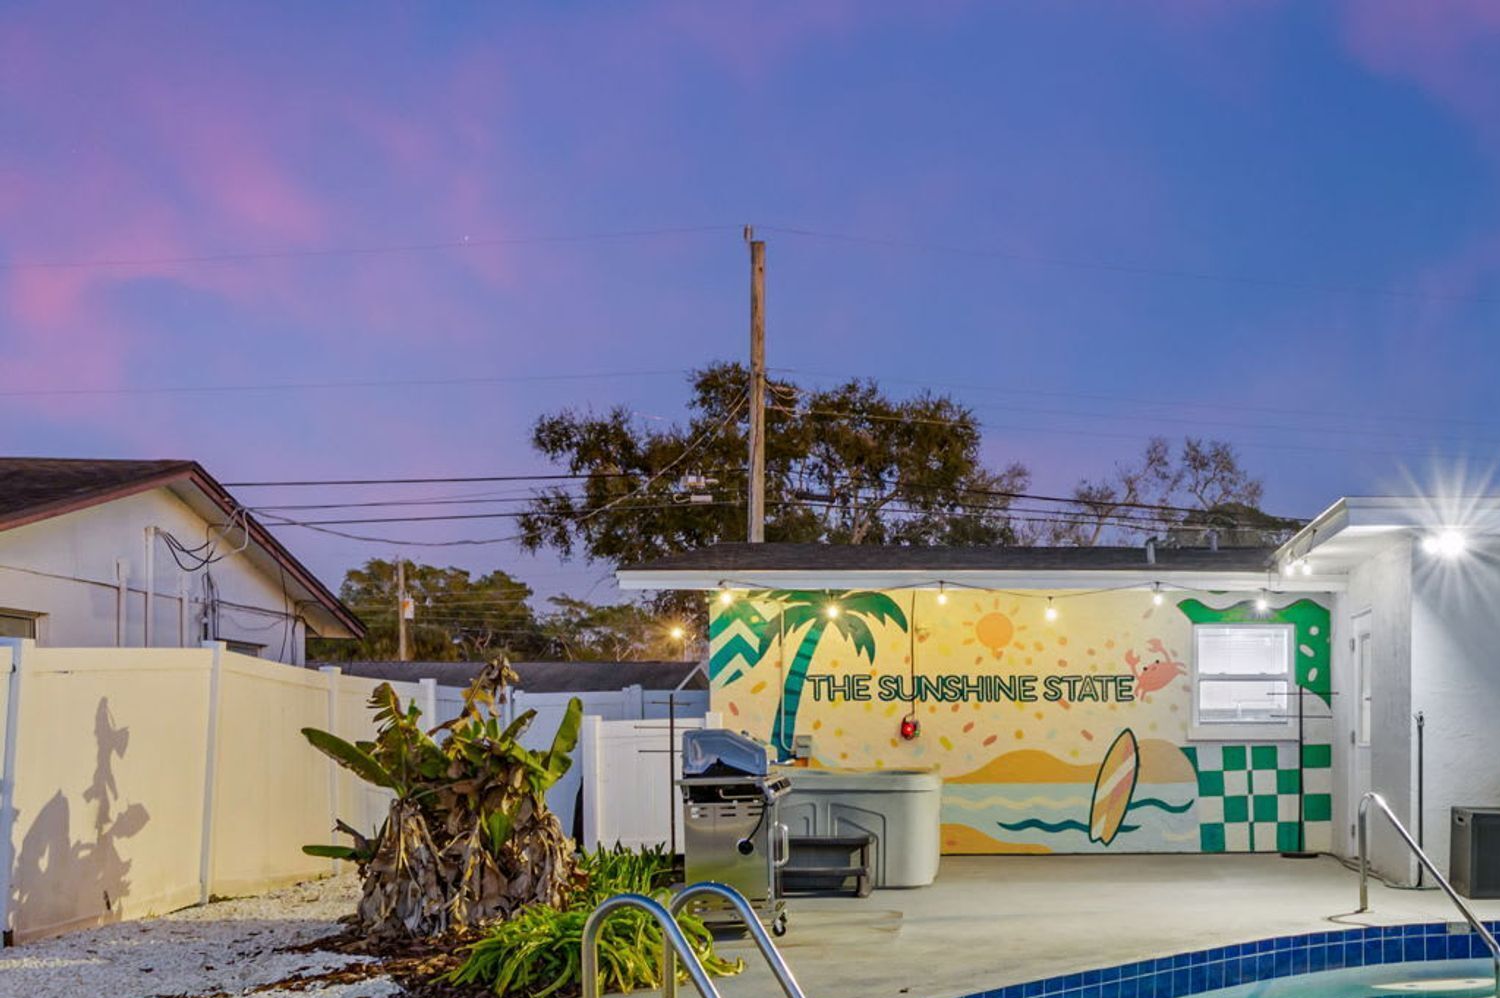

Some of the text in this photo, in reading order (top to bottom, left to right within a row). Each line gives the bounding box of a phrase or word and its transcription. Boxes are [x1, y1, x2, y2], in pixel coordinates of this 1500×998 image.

[806, 674, 1135, 702] THE SUNSHINE STATE
